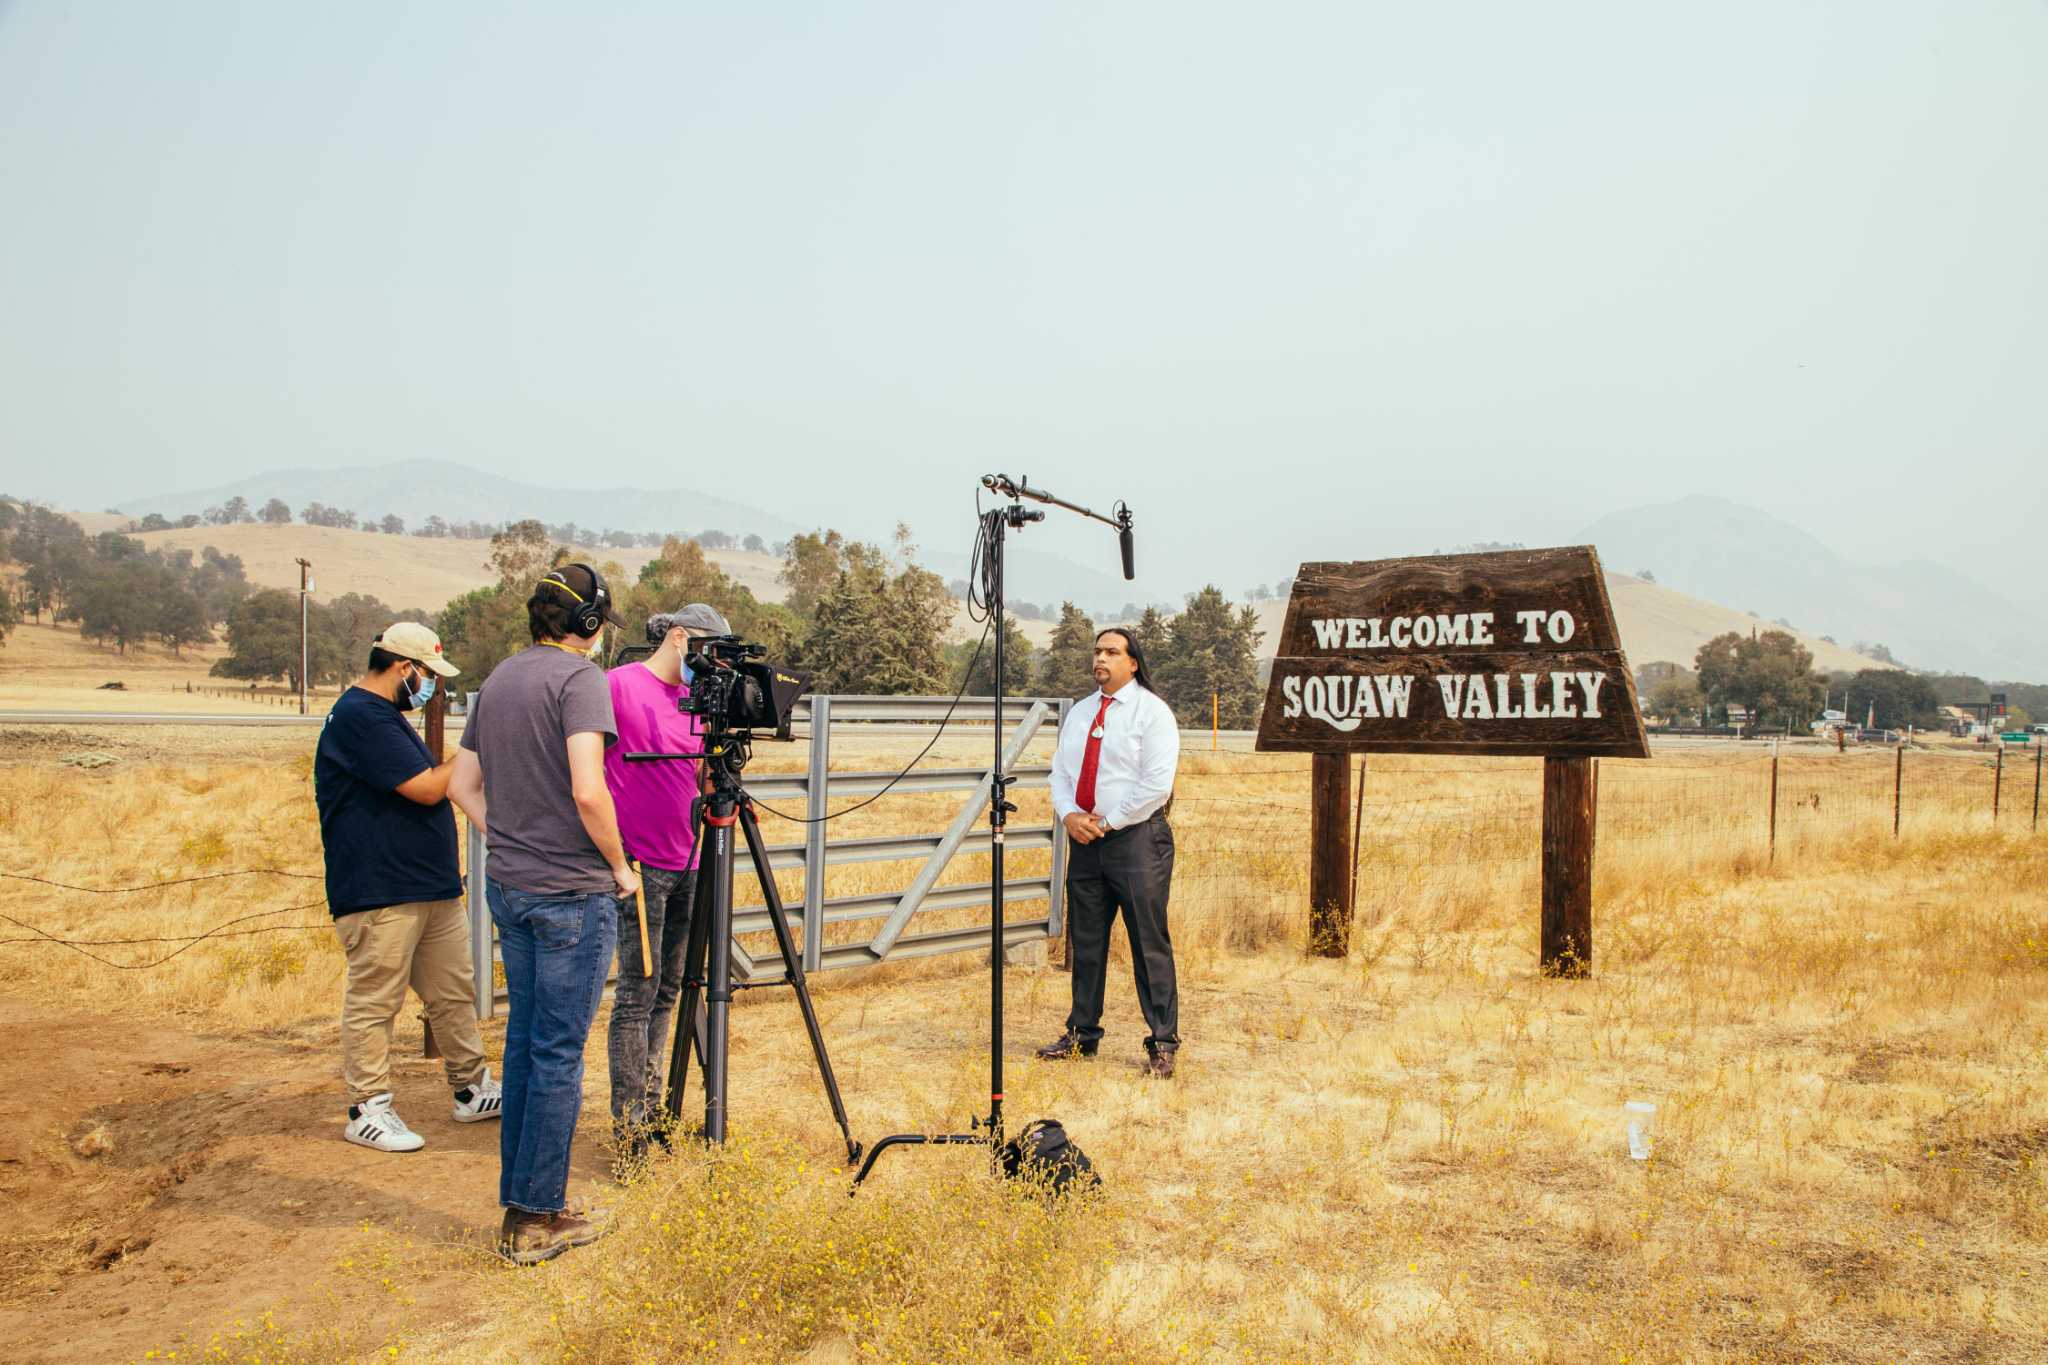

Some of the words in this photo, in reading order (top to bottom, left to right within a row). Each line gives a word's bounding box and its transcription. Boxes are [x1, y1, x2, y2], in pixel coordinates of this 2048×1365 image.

[1312, 613, 1494, 649] WELCOME
[1517, 610, 1575, 643] TO
[1283, 675, 1415, 731] SQUAW
[1436, 672, 1606, 719] VALLEY
